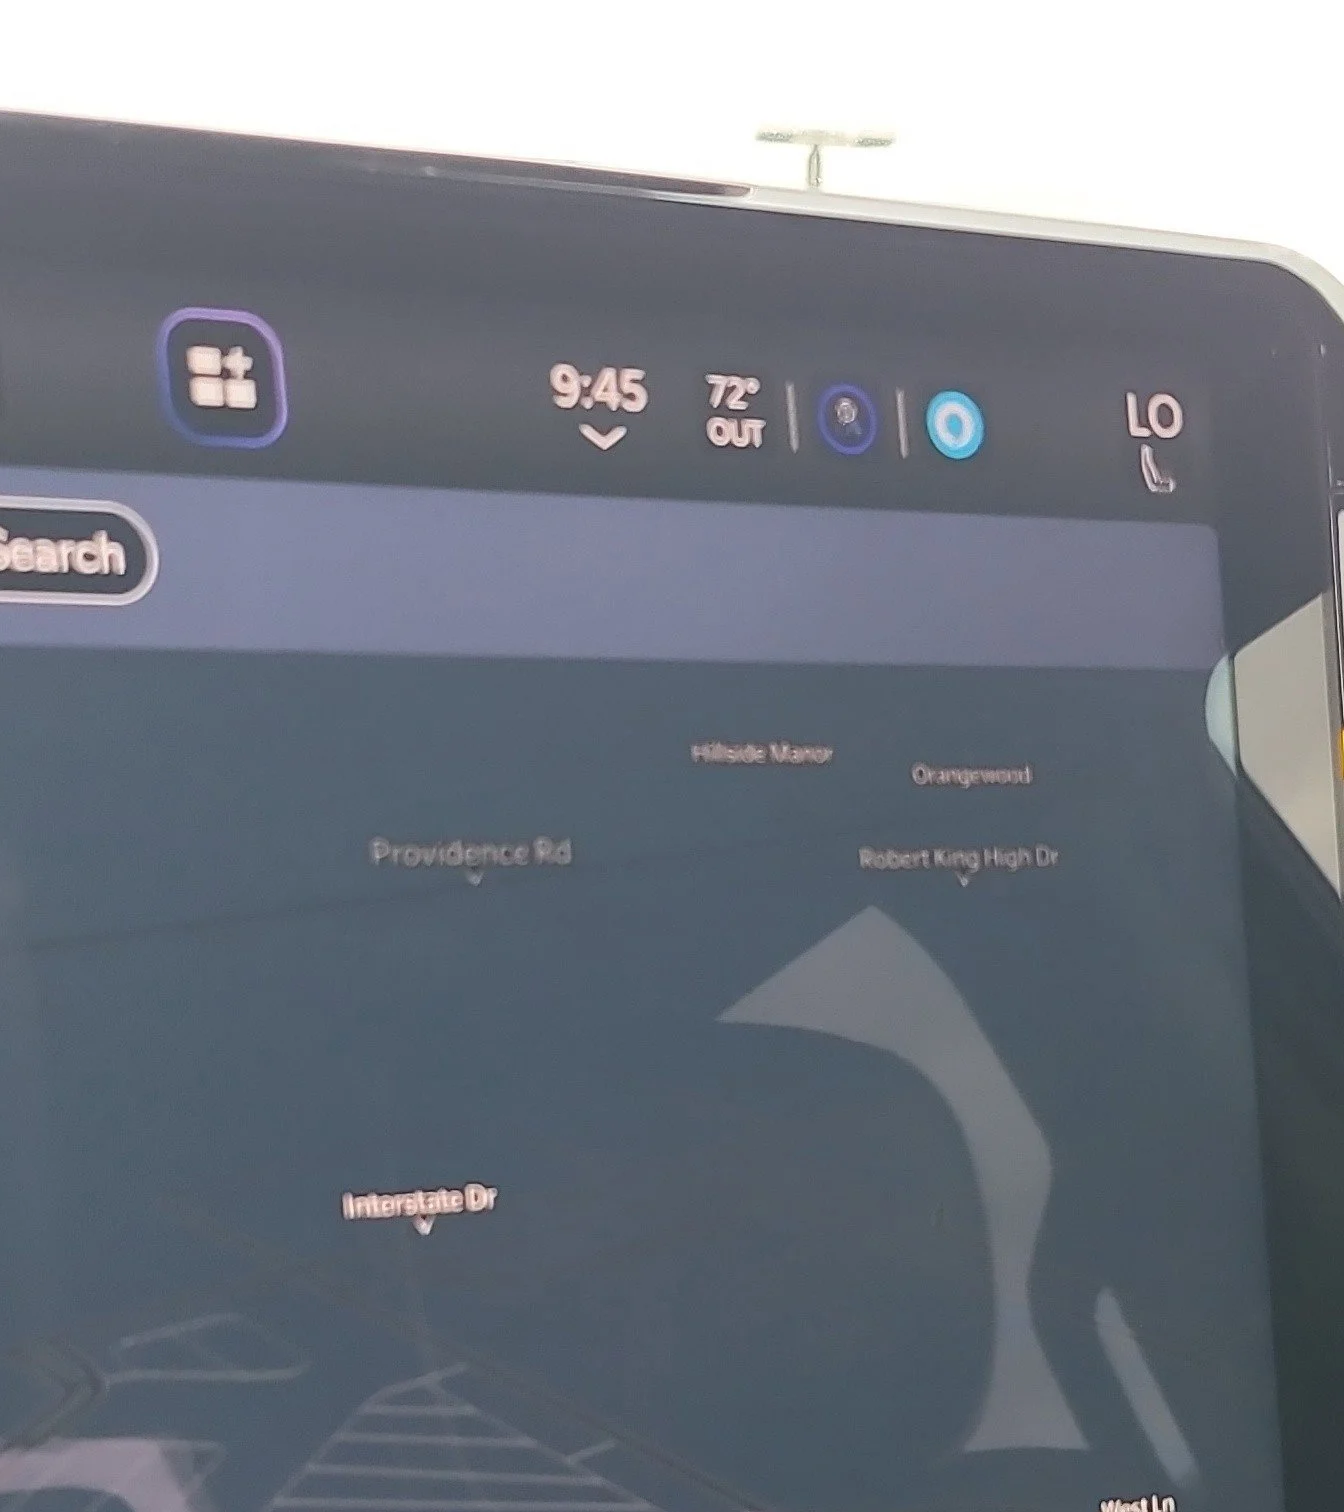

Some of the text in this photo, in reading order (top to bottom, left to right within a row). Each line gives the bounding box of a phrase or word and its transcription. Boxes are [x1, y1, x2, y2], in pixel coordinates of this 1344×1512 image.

[549, 363, 649, 413] 9:45
[704, 415, 766, 449] OUT
[1125, 391, 1185, 440] LO
[370, 835, 571, 867] Providence Rd
[342, 1182, 498, 1220] Interstate Dr
